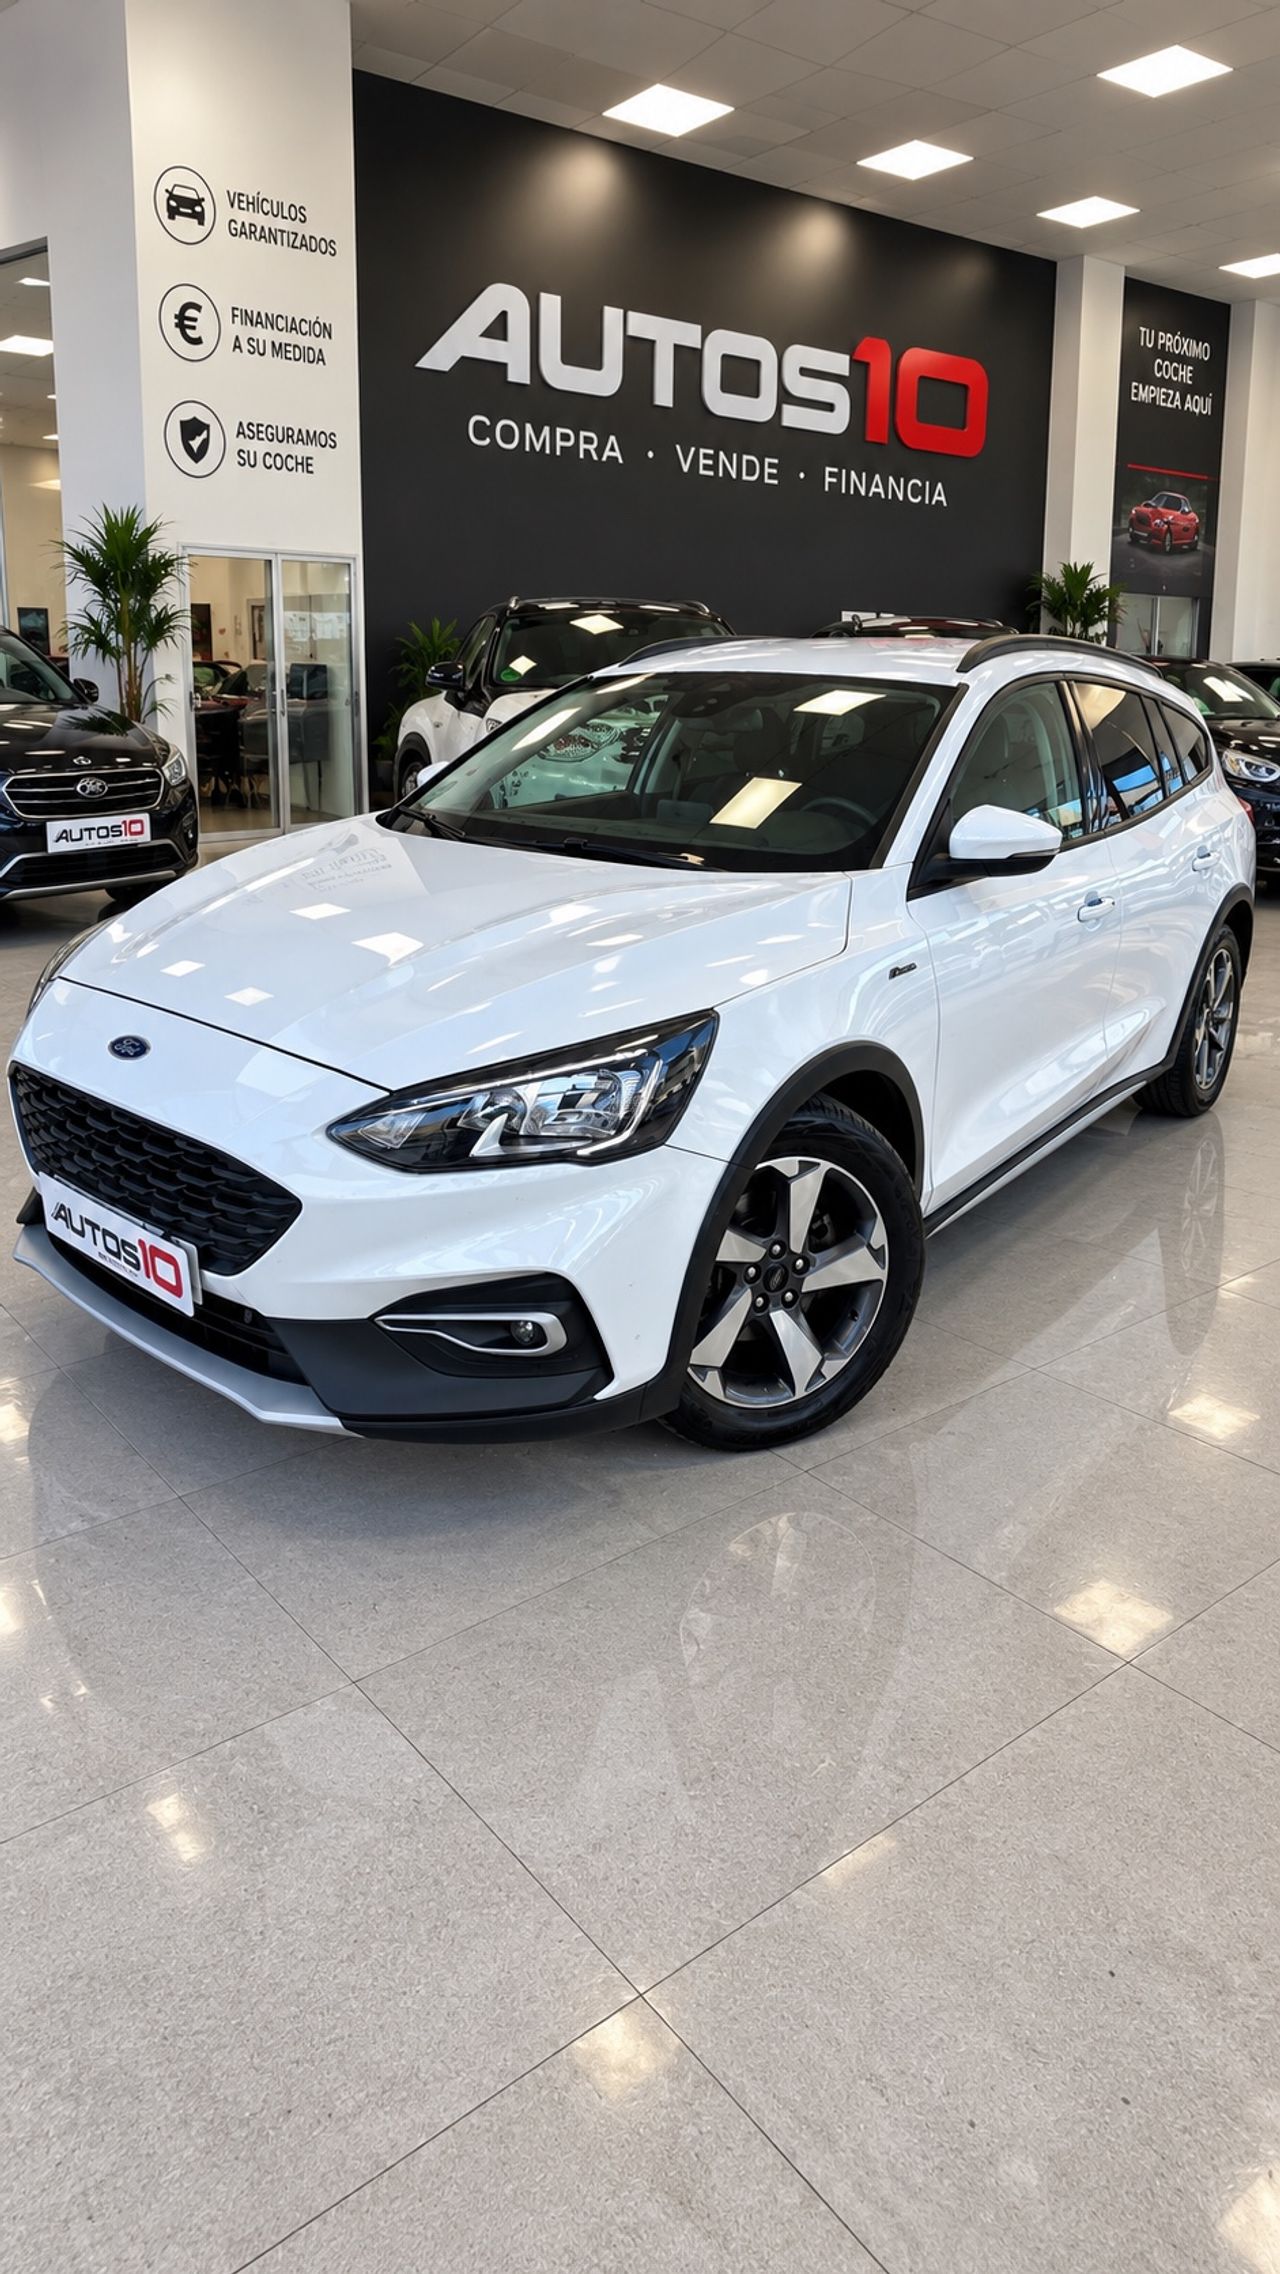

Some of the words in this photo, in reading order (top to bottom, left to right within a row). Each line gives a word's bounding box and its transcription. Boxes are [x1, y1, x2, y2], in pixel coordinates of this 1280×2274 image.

[226, 190, 307, 224] VEHÍCULOS
[228, 218, 337, 257] GARANTIZADOS
[231, 306, 332, 340] FINANCIACIÓN
[232, 335, 243, 354] A
[247, 336, 266, 357] SU
[271, 340, 326, 366] MEDIDA
[1139, 326, 1155, 348] TU
[1157, 331, 1211, 361] PRÓXIMO
[414, 282, 989, 458] AUTOS10
[1154, 358, 1193, 384] COCHE
[1131, 381, 1181, 409] EMPIEZA
[1184, 392, 1212, 416] AQUÍ
[236, 421, 337, 449] ASEGURAMOS
[237, 448, 257, 468] SU
[262, 451, 314, 474] COCHE
[468, 414, 624, 464] COMPRA
[675, 443, 780, 485] VENDE
[824, 466, 948, 507] FINANCIA
[54, 819, 144, 843] AUTOS10
[51, 1201, 183, 1299] AUTOS10
